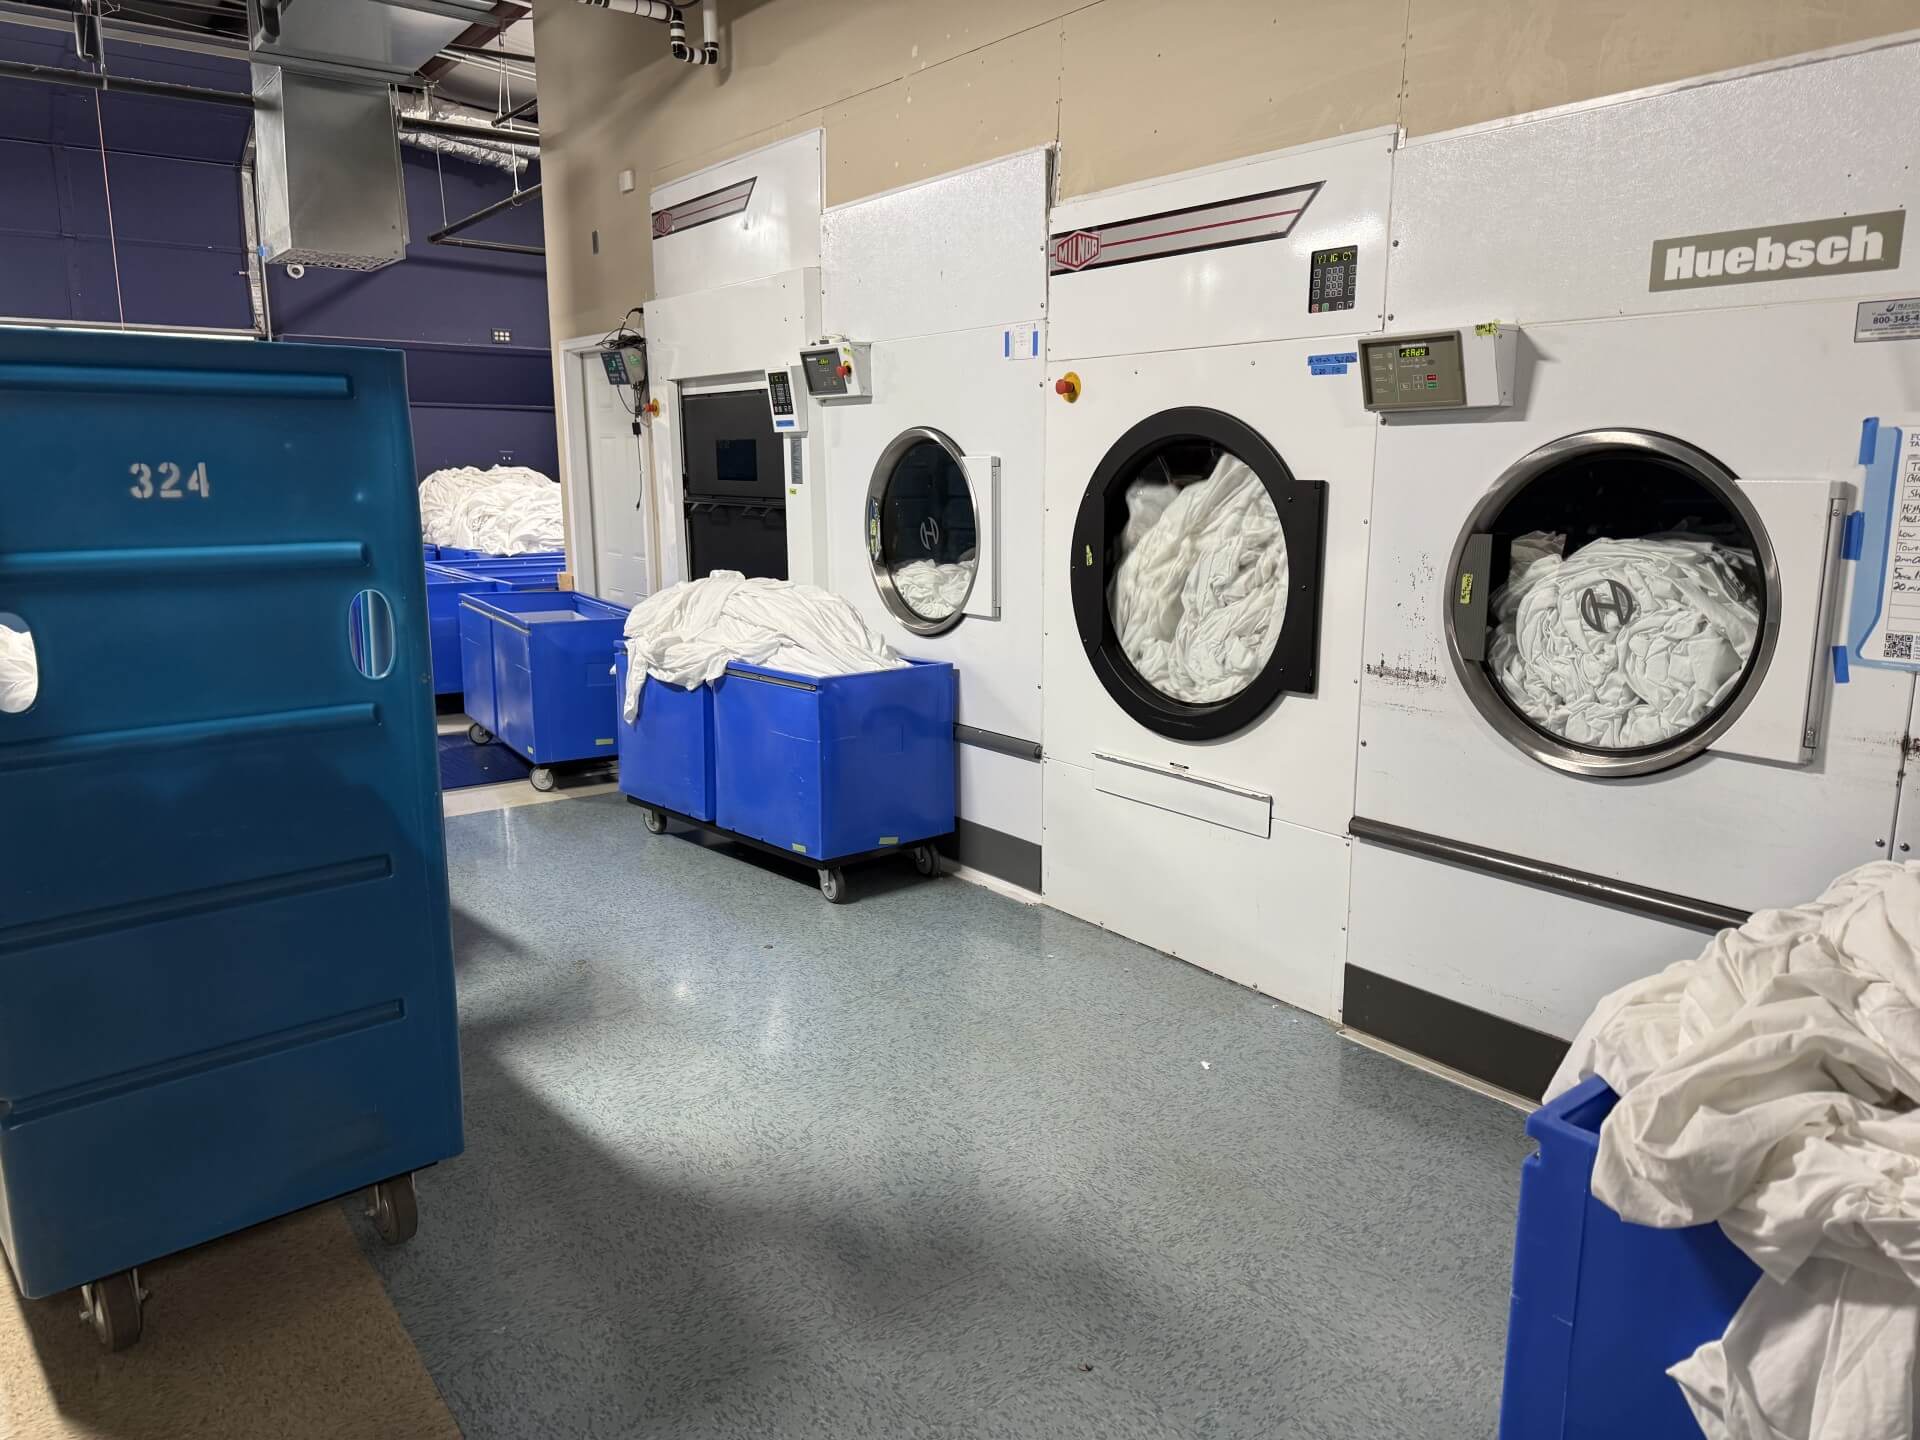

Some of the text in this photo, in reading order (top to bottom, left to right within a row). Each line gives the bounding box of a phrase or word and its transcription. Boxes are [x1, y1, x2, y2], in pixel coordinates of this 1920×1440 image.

[1057, 234, 1099, 266] MILNOR
[1664, 225, 1883, 281] Huebsch
[130, 462, 209, 498] 324
